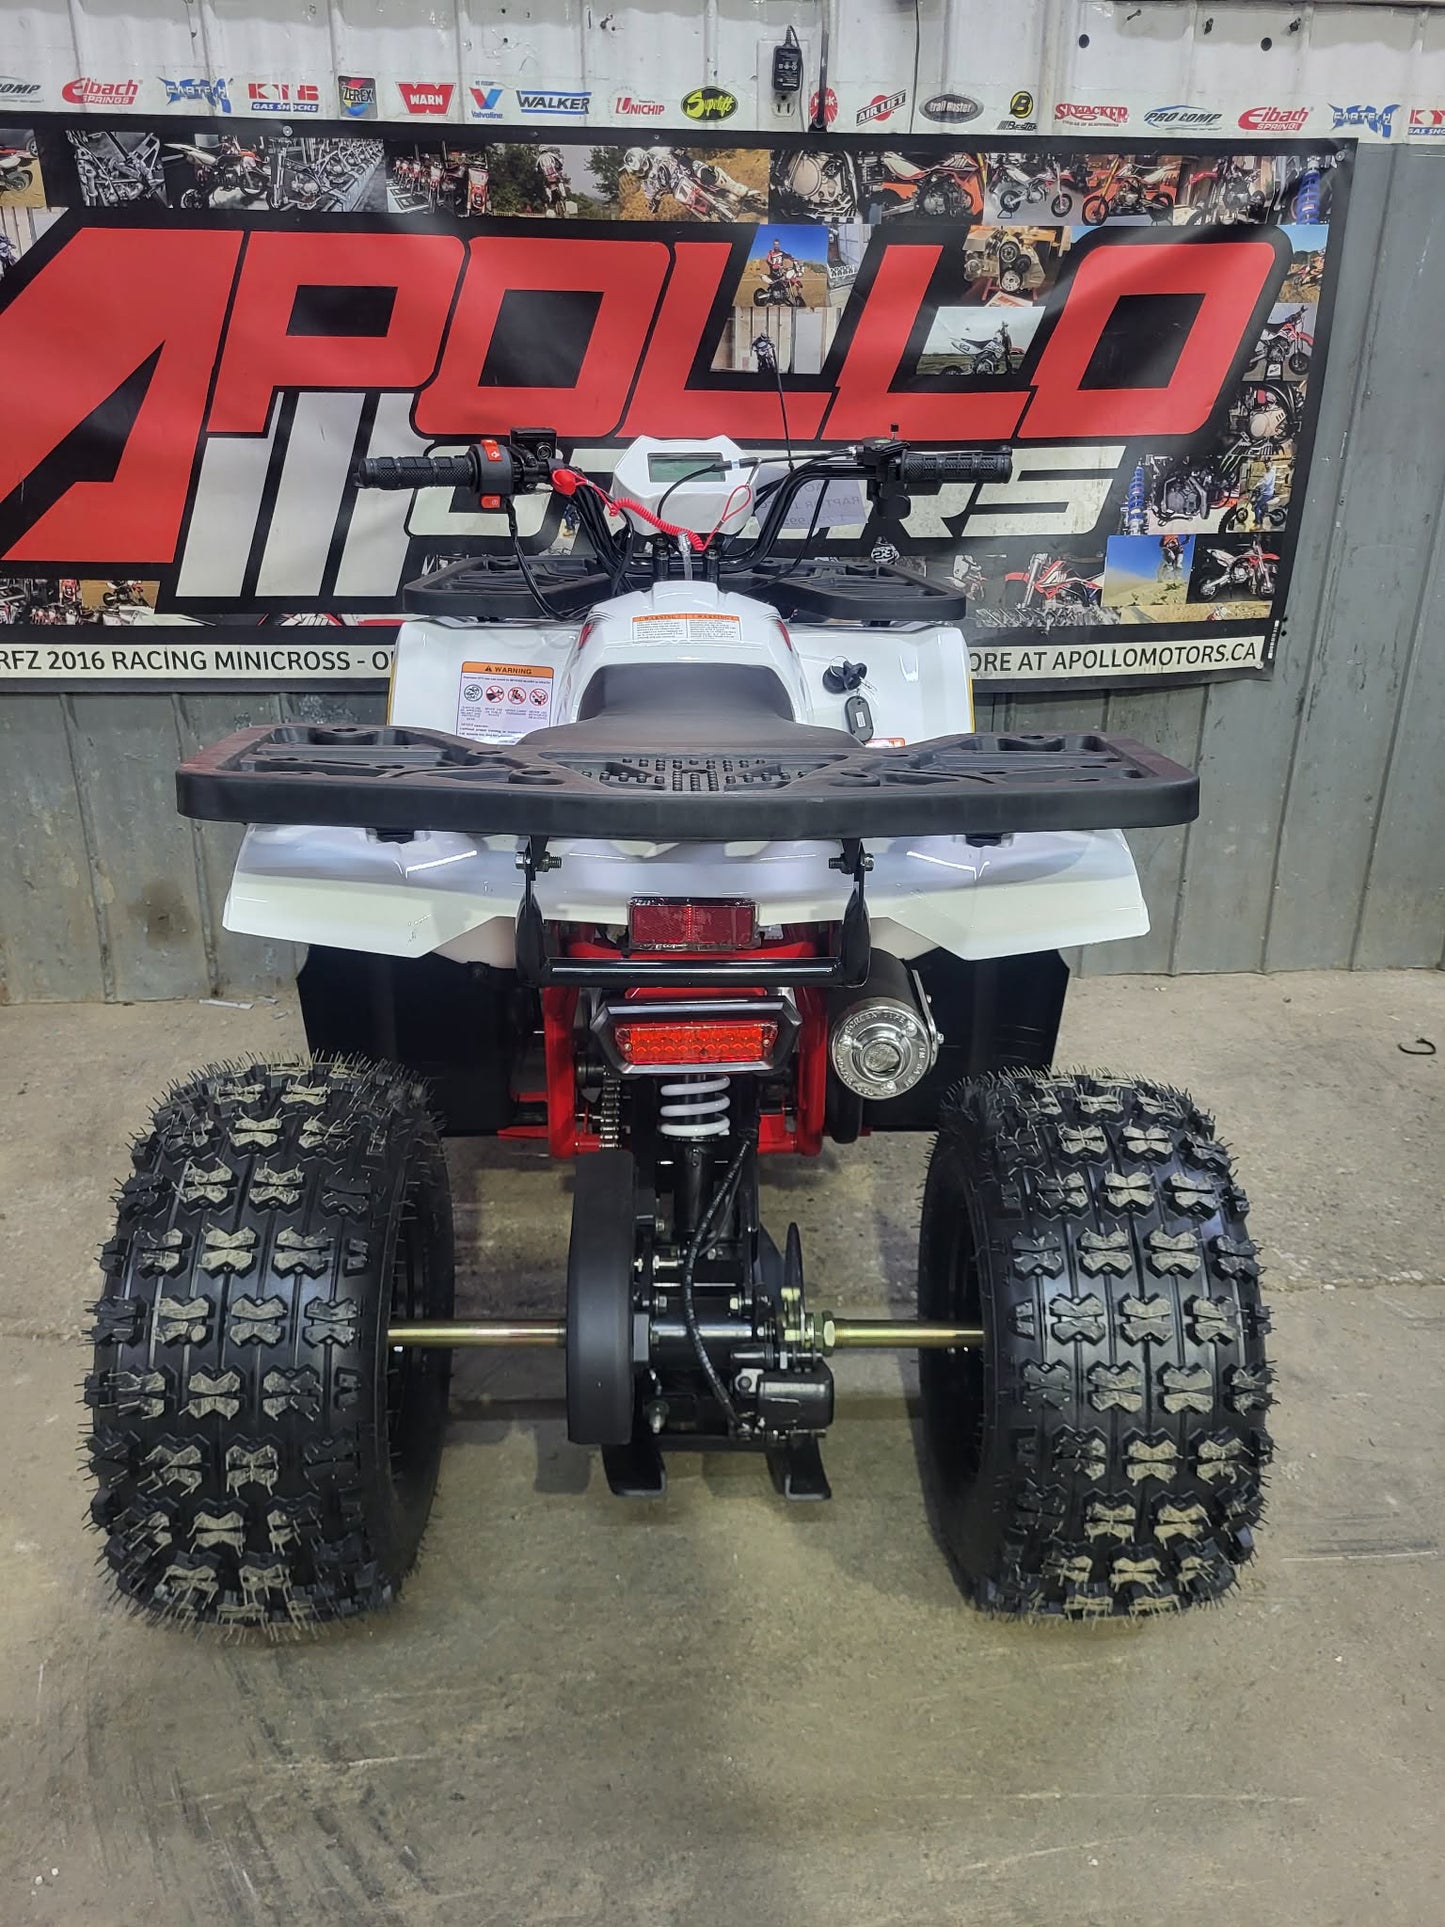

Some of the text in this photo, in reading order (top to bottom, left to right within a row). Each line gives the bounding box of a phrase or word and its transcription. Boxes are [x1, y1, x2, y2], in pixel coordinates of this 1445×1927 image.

[0, 84, 41, 94] OMP
[62, 77, 138, 104] Eibach
[342, 86, 374, 103] ZEREX
[410, 94, 443, 106] WARN
[516, 90, 590, 114] WALKER
[615, 97, 665, 115] UNICHIP
[472, 110, 503, 119] Valvoline
[858, 107, 878, 122] AIR
[1144, 112, 1223, 123] PRO COMP
[1238, 106, 1310, 130] Eibach
[0, 227, 1275, 562] APOLLO
[0, 650, 42, 670] RFZ
[47, 650, 105, 670] 2016
[112, 651, 206, 671] RACING
[215, 651, 350, 671] MINICROSS
[1018, 652, 1047, 671] AT
[1053, 641, 1256, 670] APOLLOMOTORS.CA
[494, 666, 532, 674] WARNING
